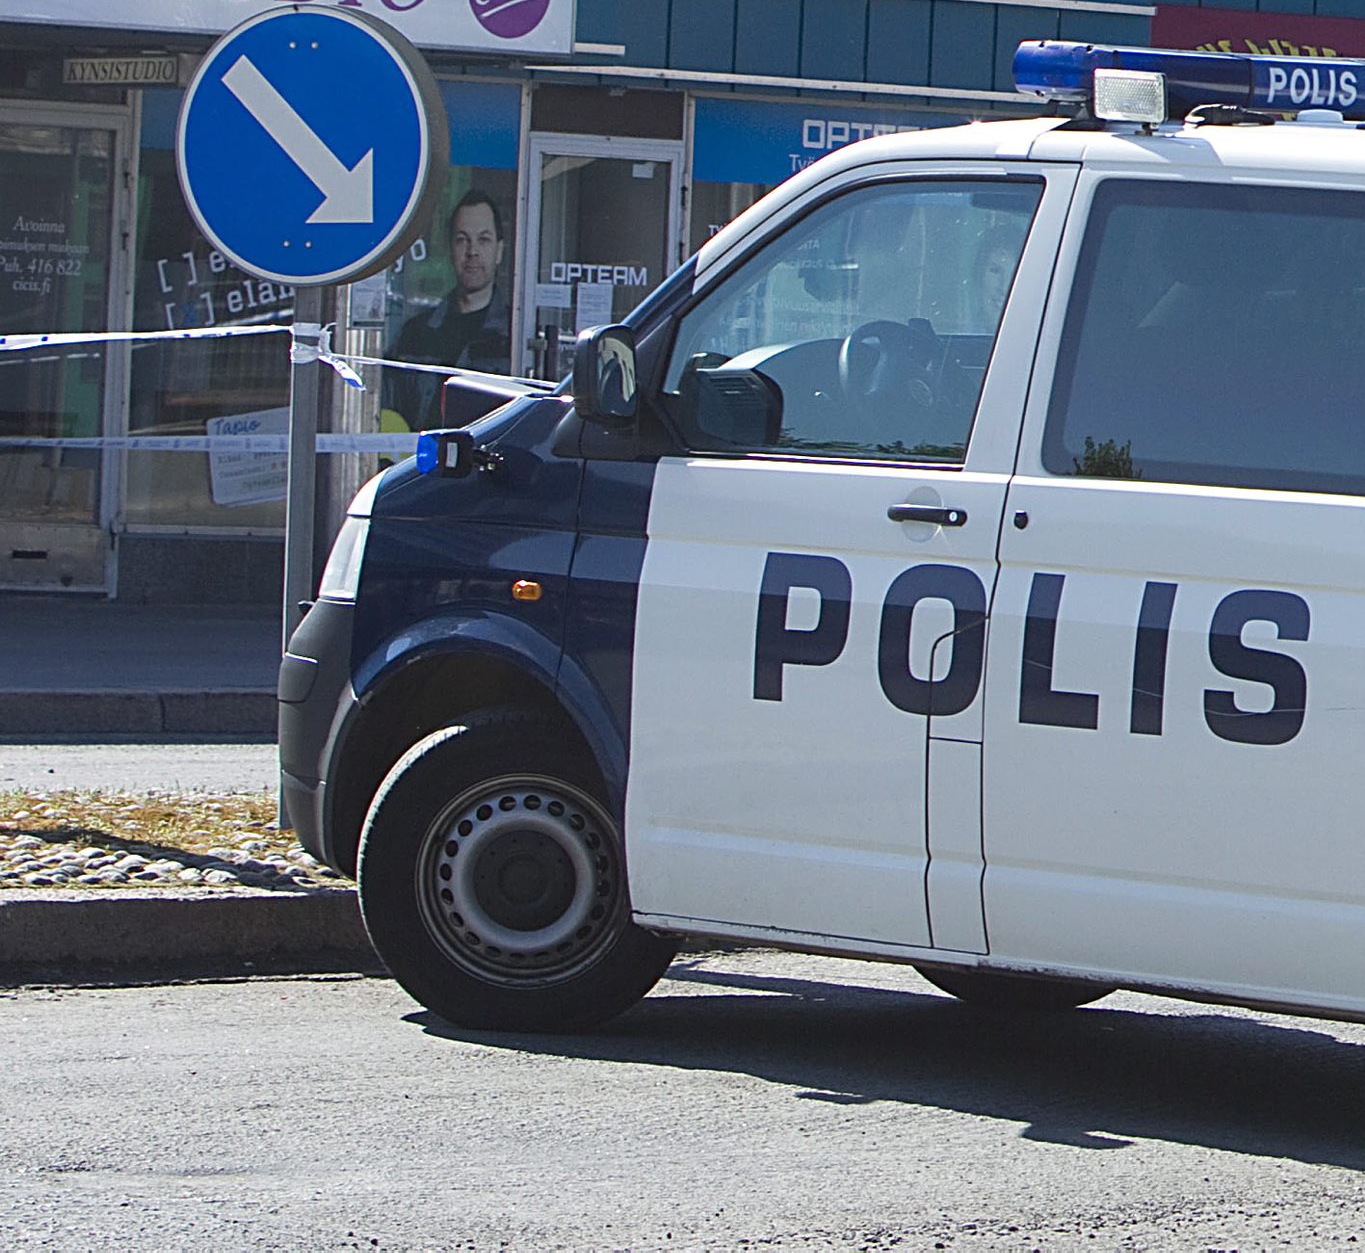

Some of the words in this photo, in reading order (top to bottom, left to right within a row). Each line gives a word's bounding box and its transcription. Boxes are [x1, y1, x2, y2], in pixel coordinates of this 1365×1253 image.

[67, 58, 175, 82] KYNSISTUDIO
[1267, 66, 1358, 107] POLIS
[28, 257, 54, 274] 416
[56, 259, 82, 276] 822
[551, 262, 648, 286] OPTEAM
[752, 551, 1311, 746] POLIS
